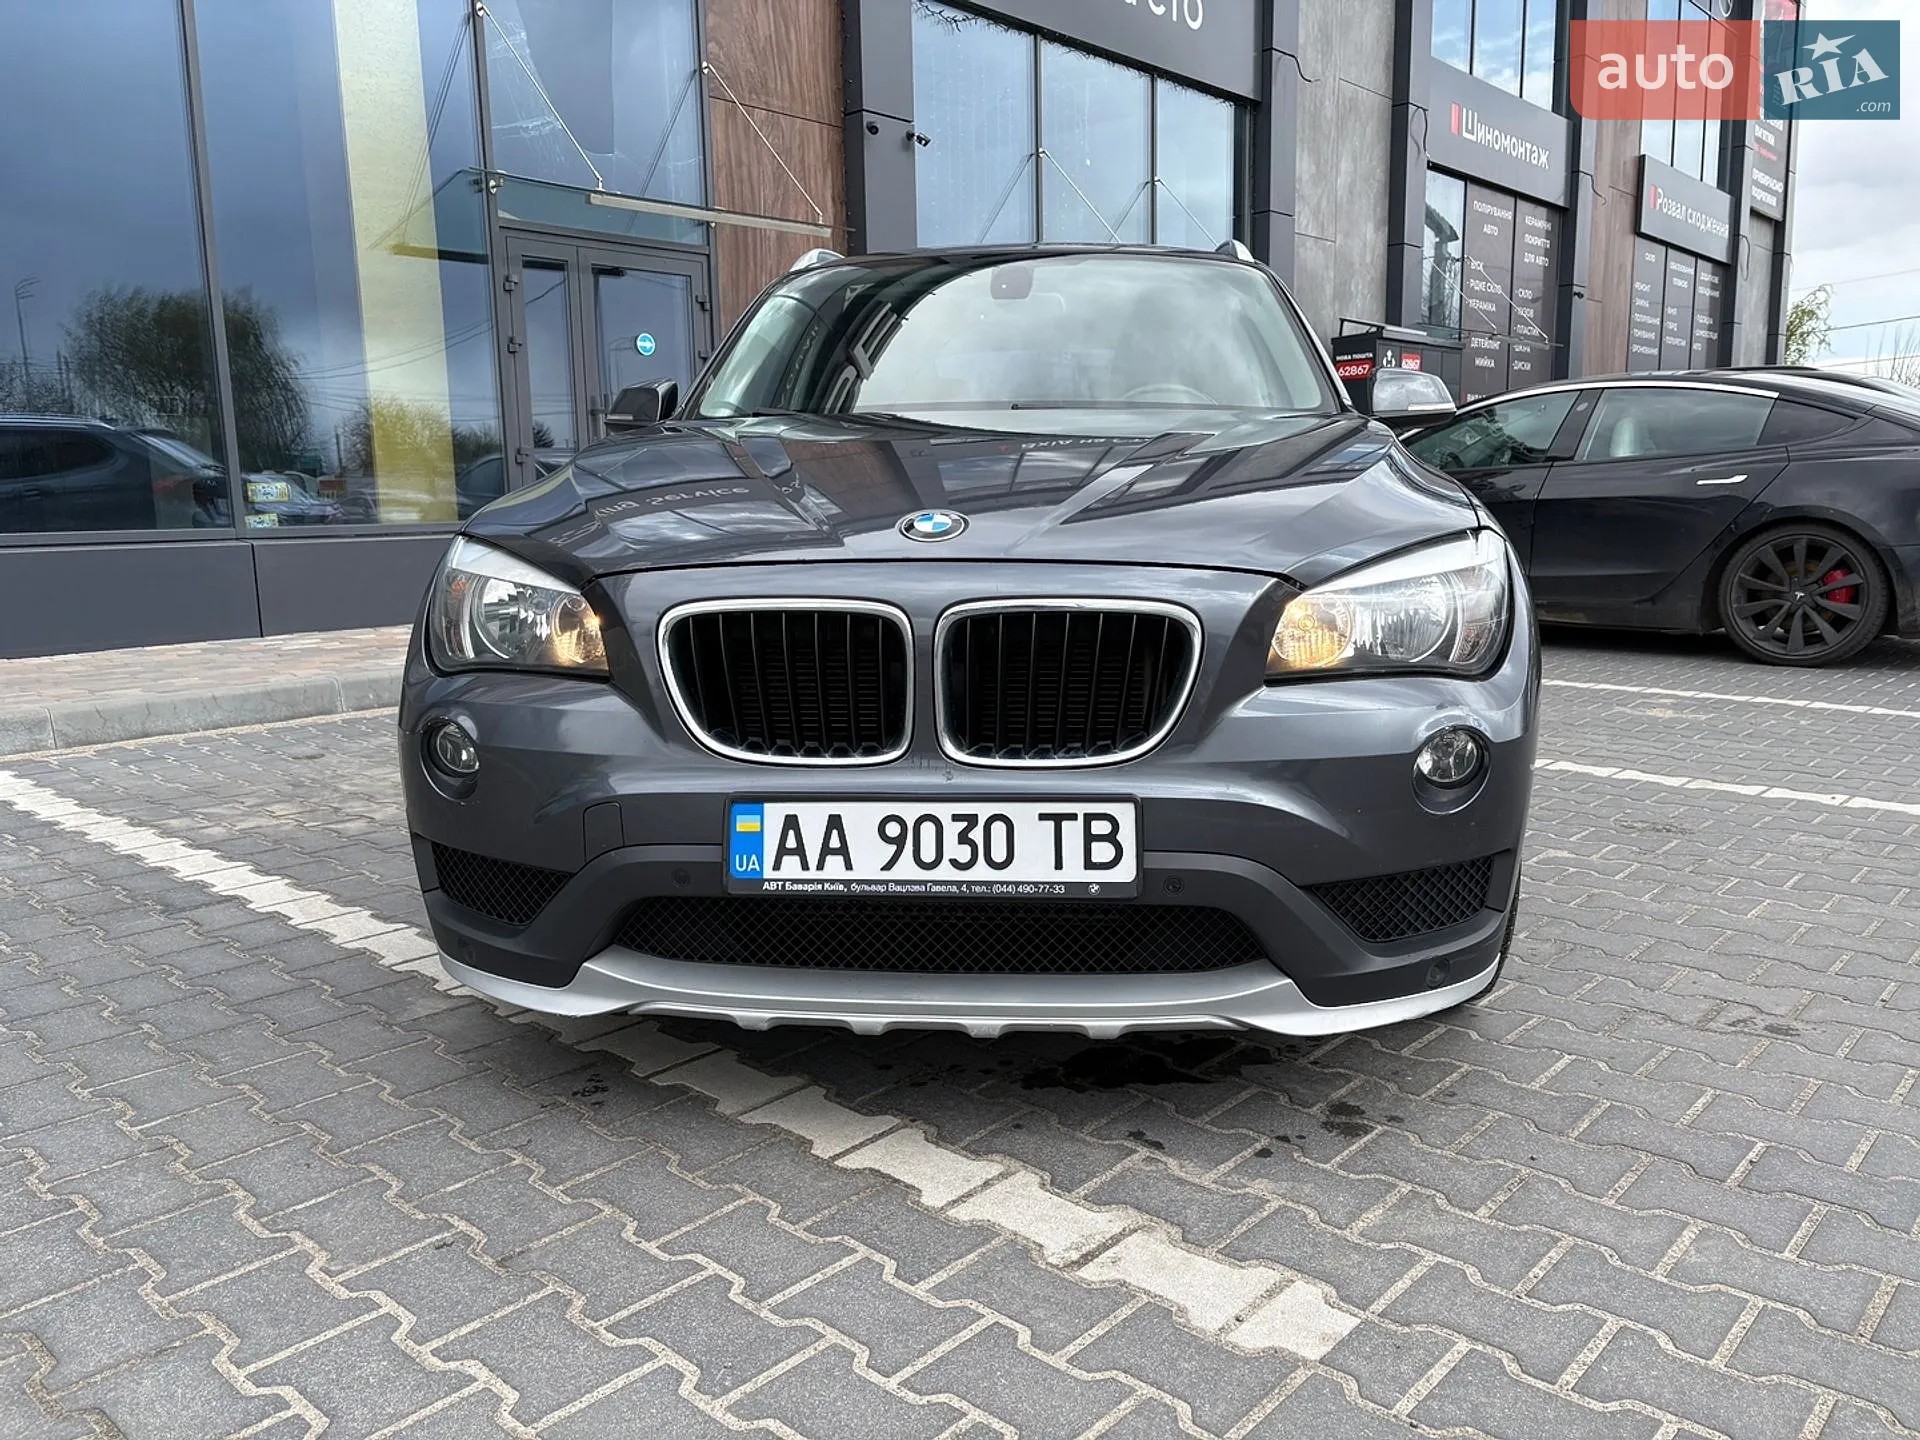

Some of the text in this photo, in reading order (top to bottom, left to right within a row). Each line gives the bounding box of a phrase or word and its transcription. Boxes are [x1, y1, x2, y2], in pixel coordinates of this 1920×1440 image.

[1462, 107, 1549, 170] Шиномонтаж
[1656, 187, 1686, 221] Розвал
[1482, 224, 1498, 236] АВТО
[1338, 364, 1370, 377] 62867
[772, 812, 1124, 871] AA 9030 TB
[735, 853, 760, 872] UA
[763, 881, 783, 891] АВТ
[785, 881, 822, 892] Баварія
[824, 882, 847, 892] Київ,
[850, 881, 886, 893] бульвар
[888, 883, 925, 893] Вацлава
[926, 883, 959, 894] Гавела,
[961, 884, 970, 894] 4,
[992, 883, 1015, 895] (044)
[1017, 884, 1065, 894] 490-77-33
